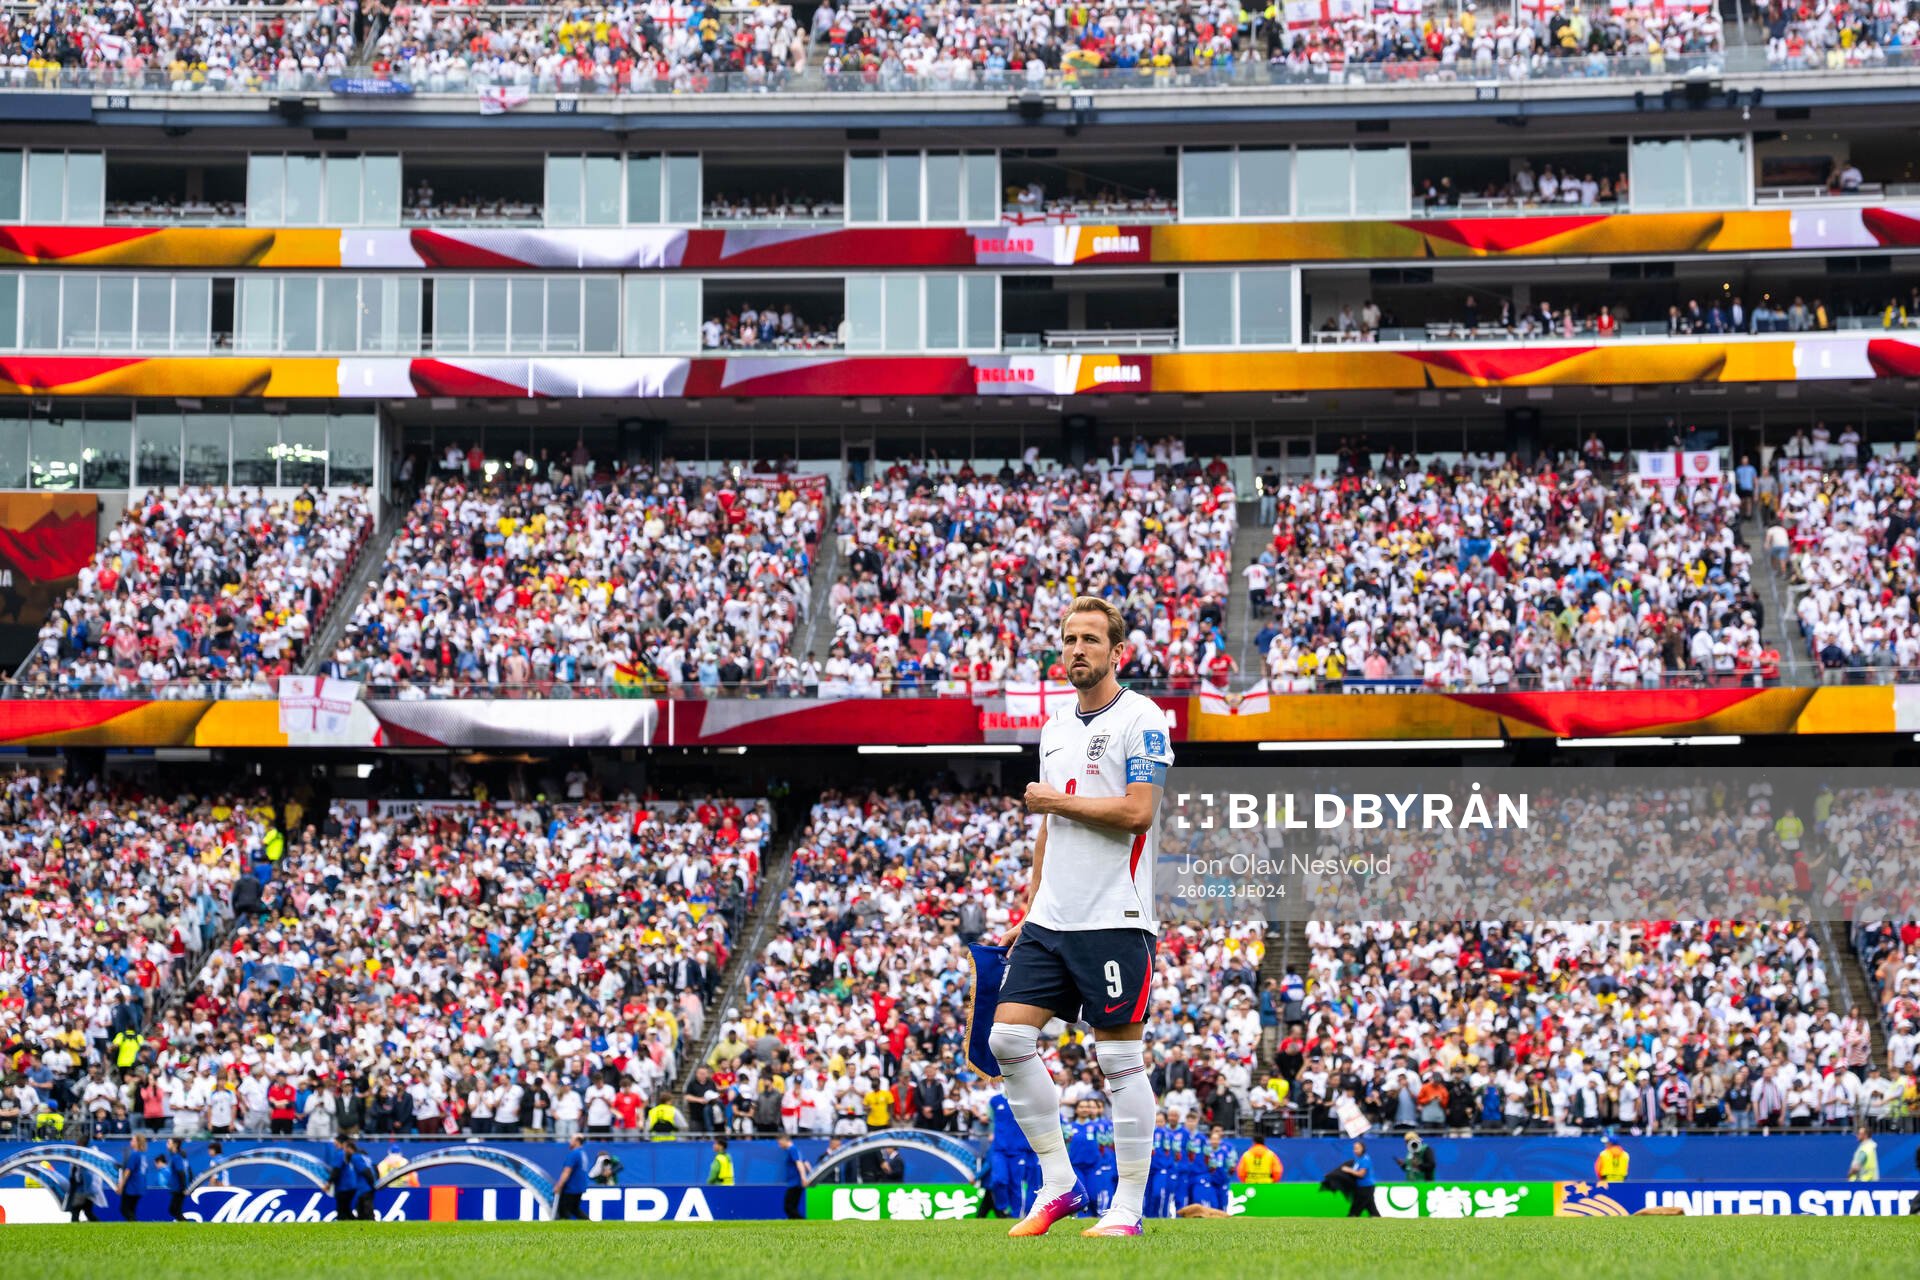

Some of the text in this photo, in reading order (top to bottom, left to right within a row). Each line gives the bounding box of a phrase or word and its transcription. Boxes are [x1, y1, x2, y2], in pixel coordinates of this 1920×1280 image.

[974, 238, 1034, 252] ENGLAND
[1093, 236, 1140, 253] GHANA
[974, 367, 1035, 382] ENGLAND
[1094, 365, 1141, 382] GHANA
[979, 711, 1048, 730] ENGLAN
[1104, 960, 1123, 998] 9
[1645, 1190, 1792, 1216] UNITED
